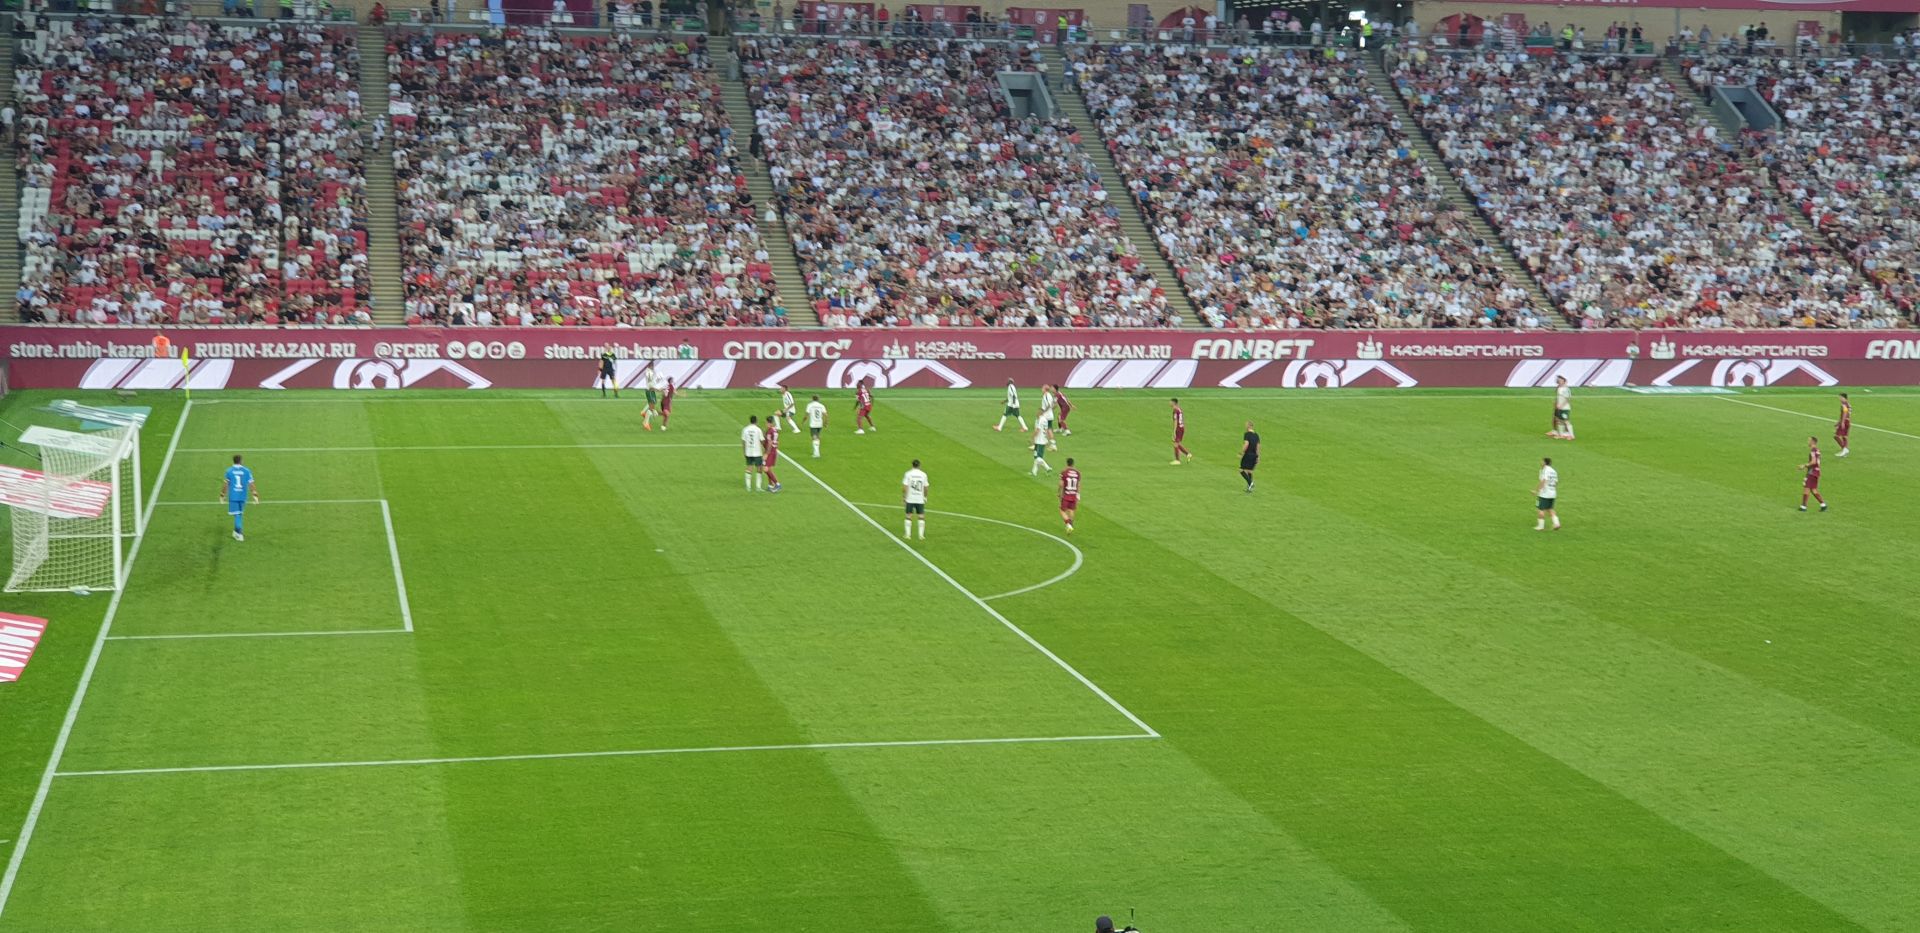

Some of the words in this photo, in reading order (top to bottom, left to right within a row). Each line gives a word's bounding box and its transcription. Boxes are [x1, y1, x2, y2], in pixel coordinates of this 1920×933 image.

[10, 341, 178, 358] store.rubin-kazanu
[195, 342, 357, 358] RUBIN-KAZAN.RU
[374, 342, 440, 359] @FCRK
[915, 341, 977, 352] КАЗАНЬ
[1031, 344, 1172, 359] RUBIN-KAZAN.RU
[1192, 339, 1315, 359] FONBET
[1390, 345, 1544, 356] КАЗАНЬОРГСИНТЕЗ
[1682, 345, 1828, 356] КАЗАНЬОРГСИНТЕЗ
[234, 475, 243, 488] 1
